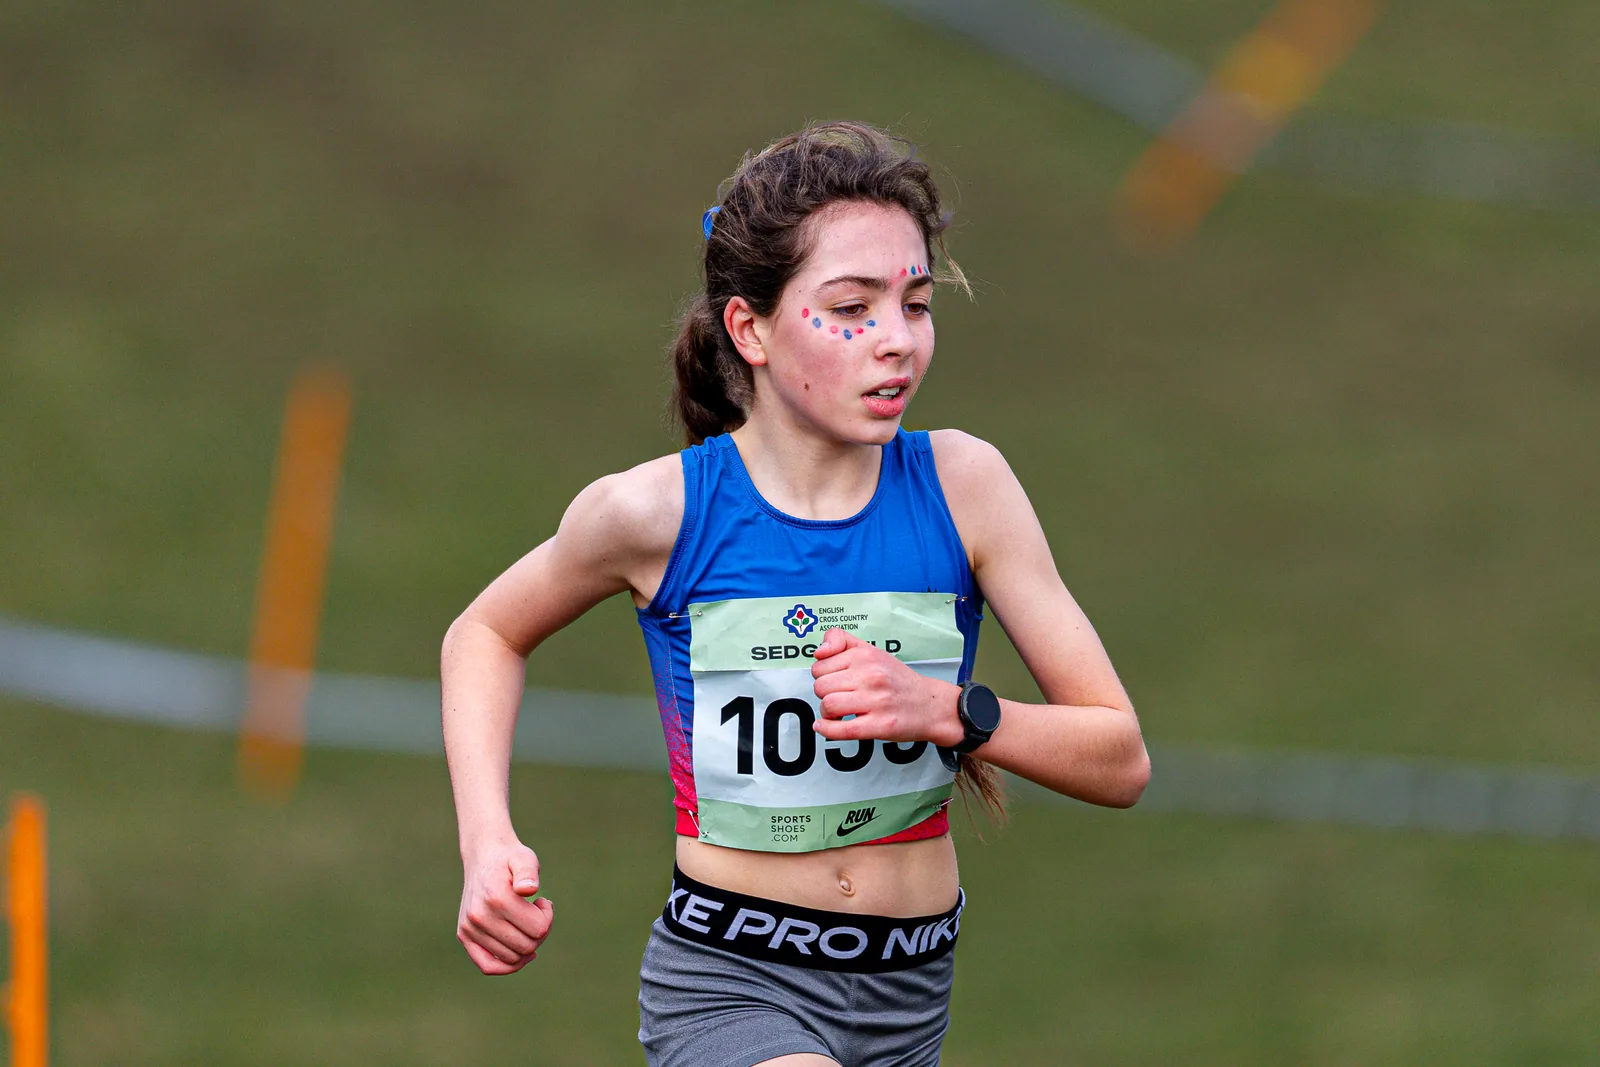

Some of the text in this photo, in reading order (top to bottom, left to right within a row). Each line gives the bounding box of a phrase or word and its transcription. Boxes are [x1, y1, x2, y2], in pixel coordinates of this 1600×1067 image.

[840, 614, 868, 622] COUNTRY
[750, 639, 902, 661] SEDGD
[771, 815, 812, 824] SPORTS
[845, 807, 876, 824] RUN
[771, 824, 806, 833] SHOES
[771, 833, 798, 842] .COM
[722, 907, 869, 960] PRO
